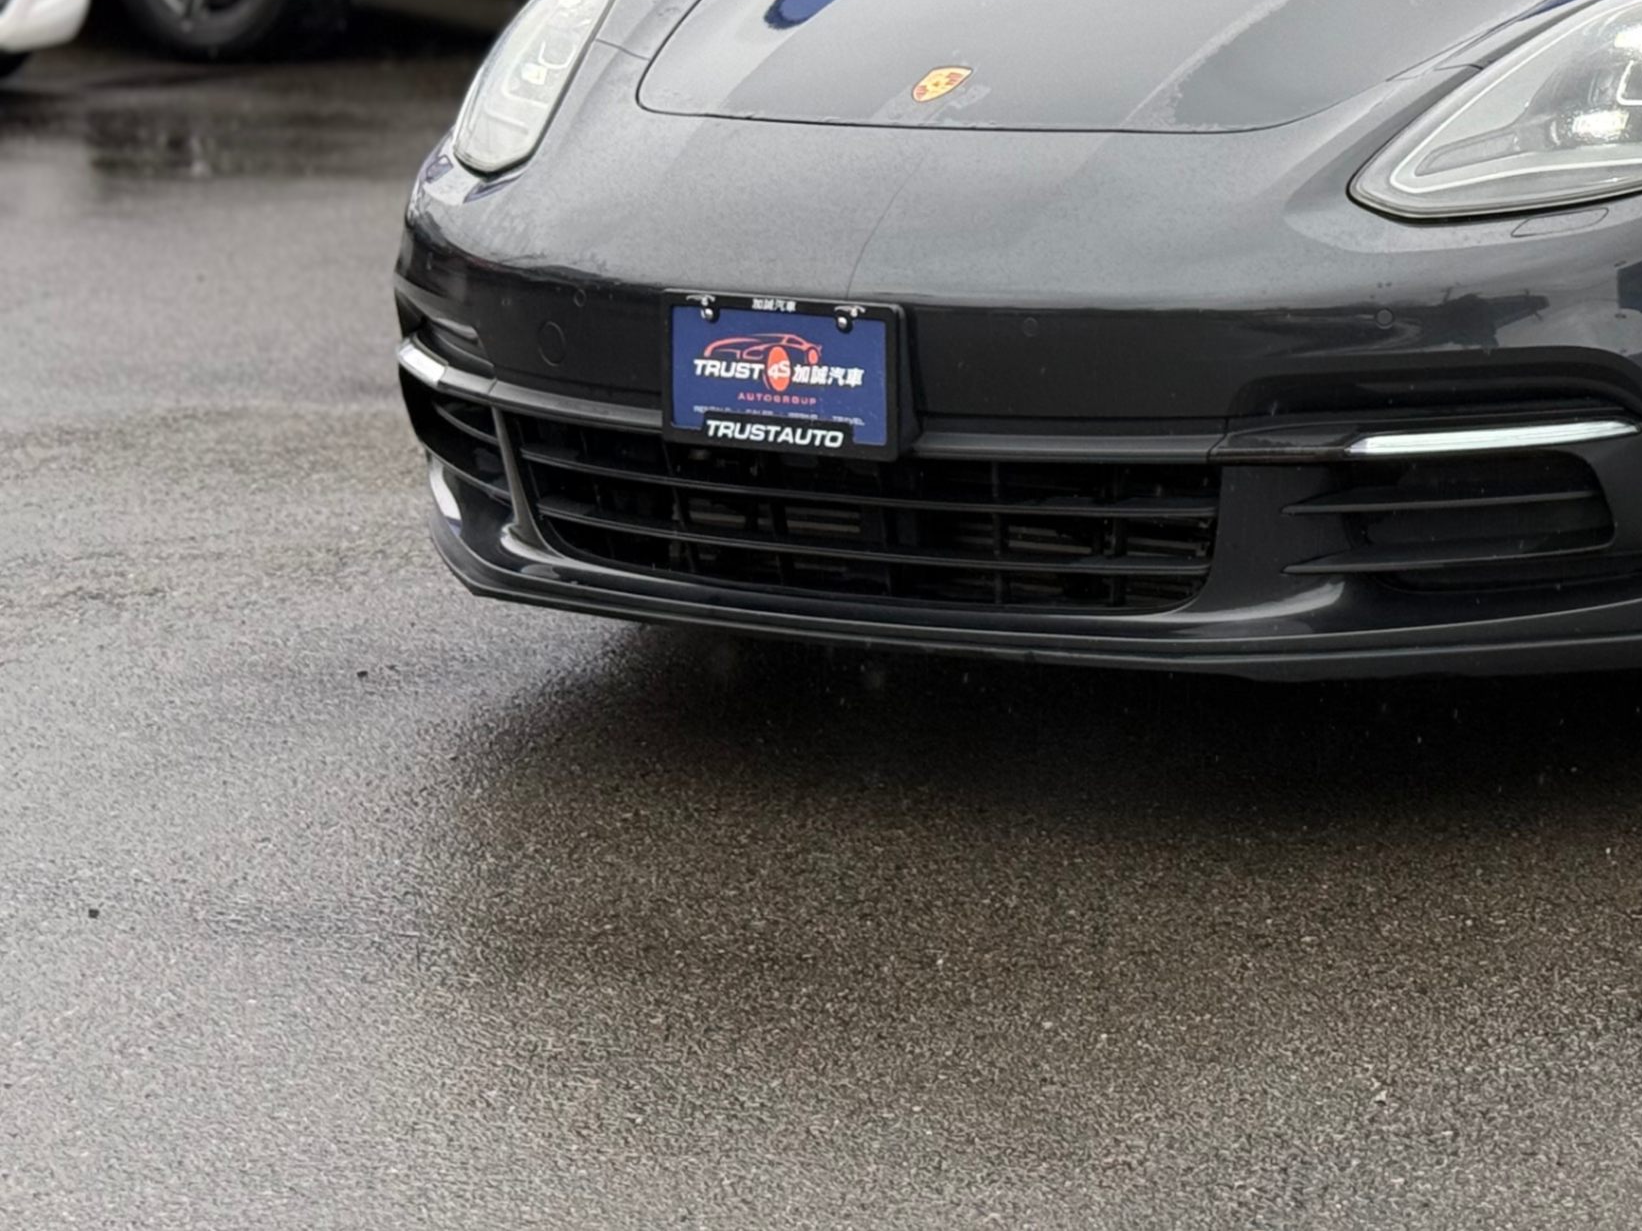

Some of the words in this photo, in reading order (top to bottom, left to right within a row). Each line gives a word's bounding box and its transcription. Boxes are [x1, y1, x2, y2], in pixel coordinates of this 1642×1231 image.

[693, 359, 765, 380] TRUST
[737, 392, 817, 405] AUTOGROUP
[706, 419, 844, 448] TRUSTAUTO
